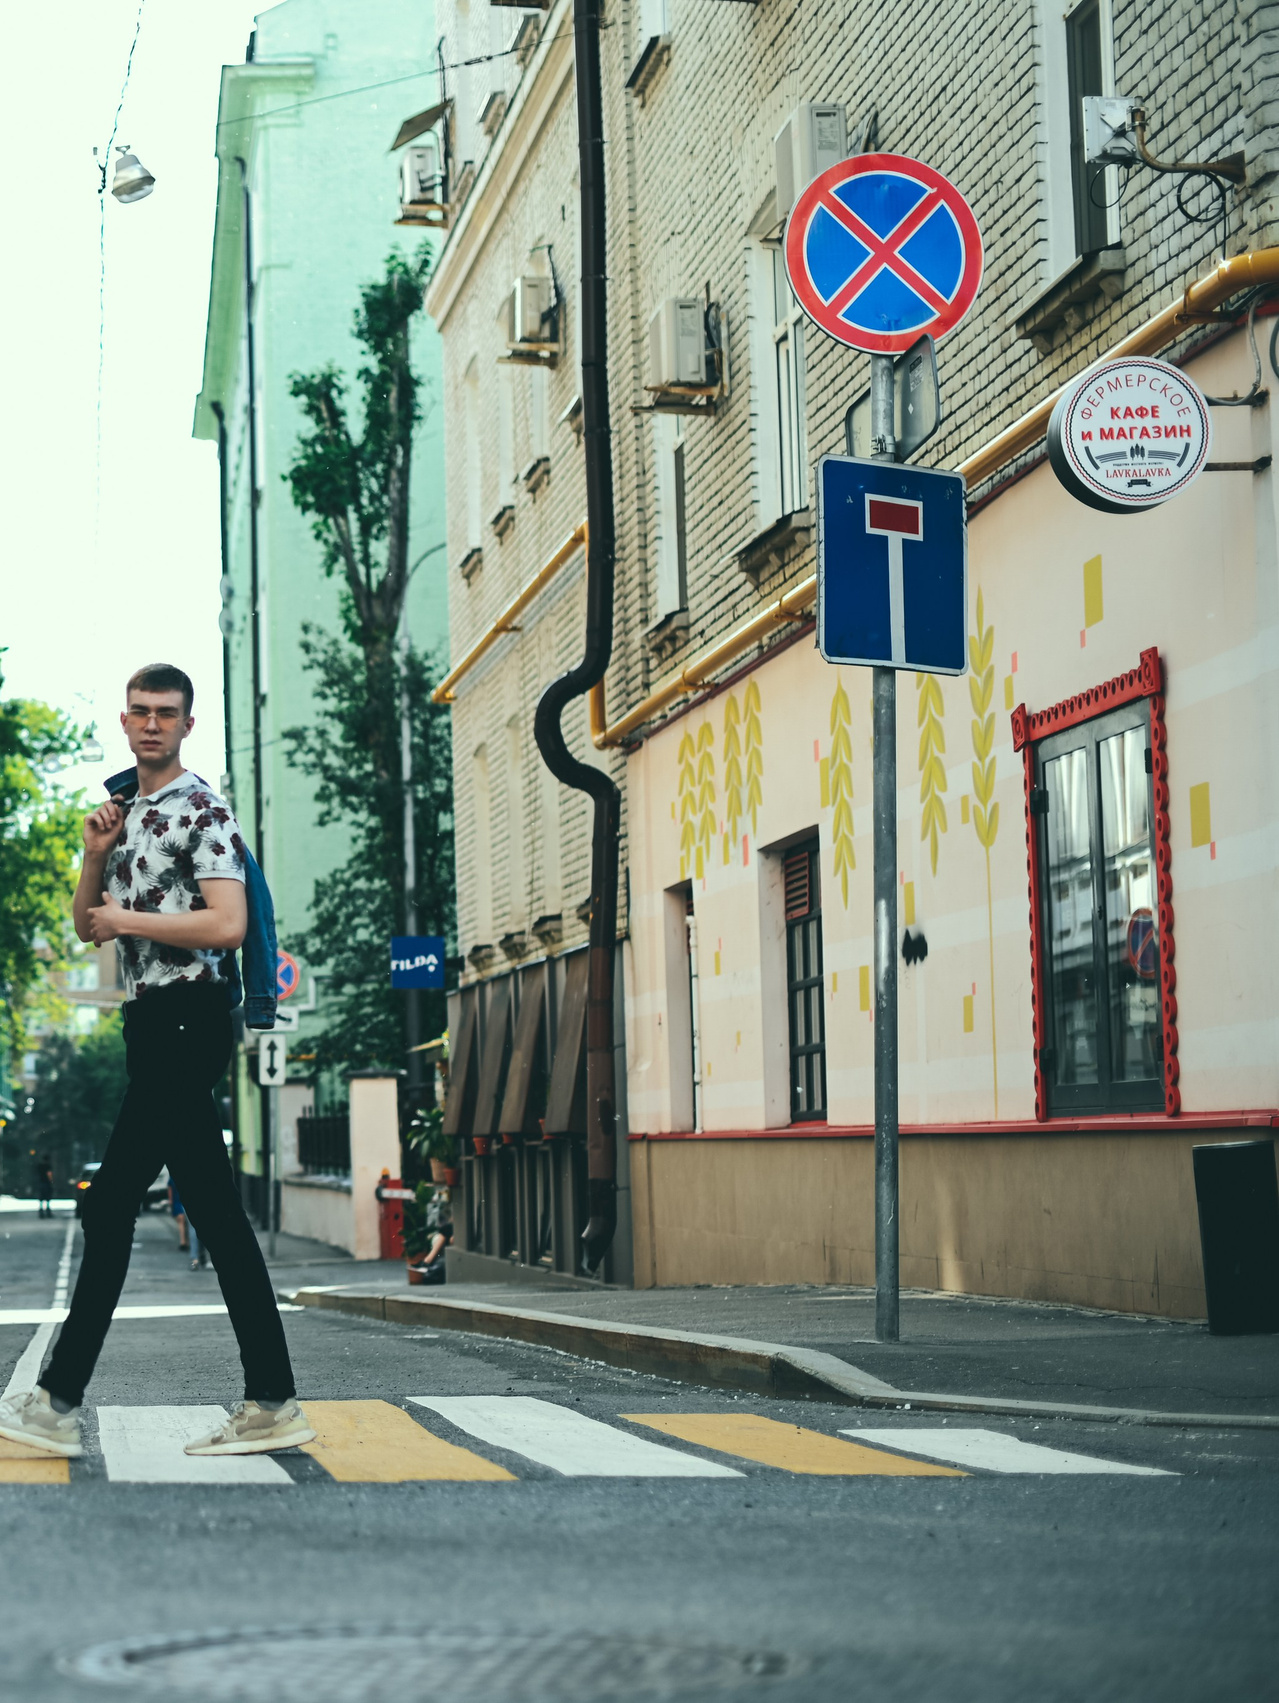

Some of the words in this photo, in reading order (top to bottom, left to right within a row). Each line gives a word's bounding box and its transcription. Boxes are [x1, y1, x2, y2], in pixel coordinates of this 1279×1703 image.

[1081, 374, 1192, 420] ФЕРМЕРСКОЕ
[1110, 405, 1160, 420] КАФЕ
[1099, 424, 1191, 441] МАГАЗИН
[1106, 467, 1171, 478] LAVKALAVKA
